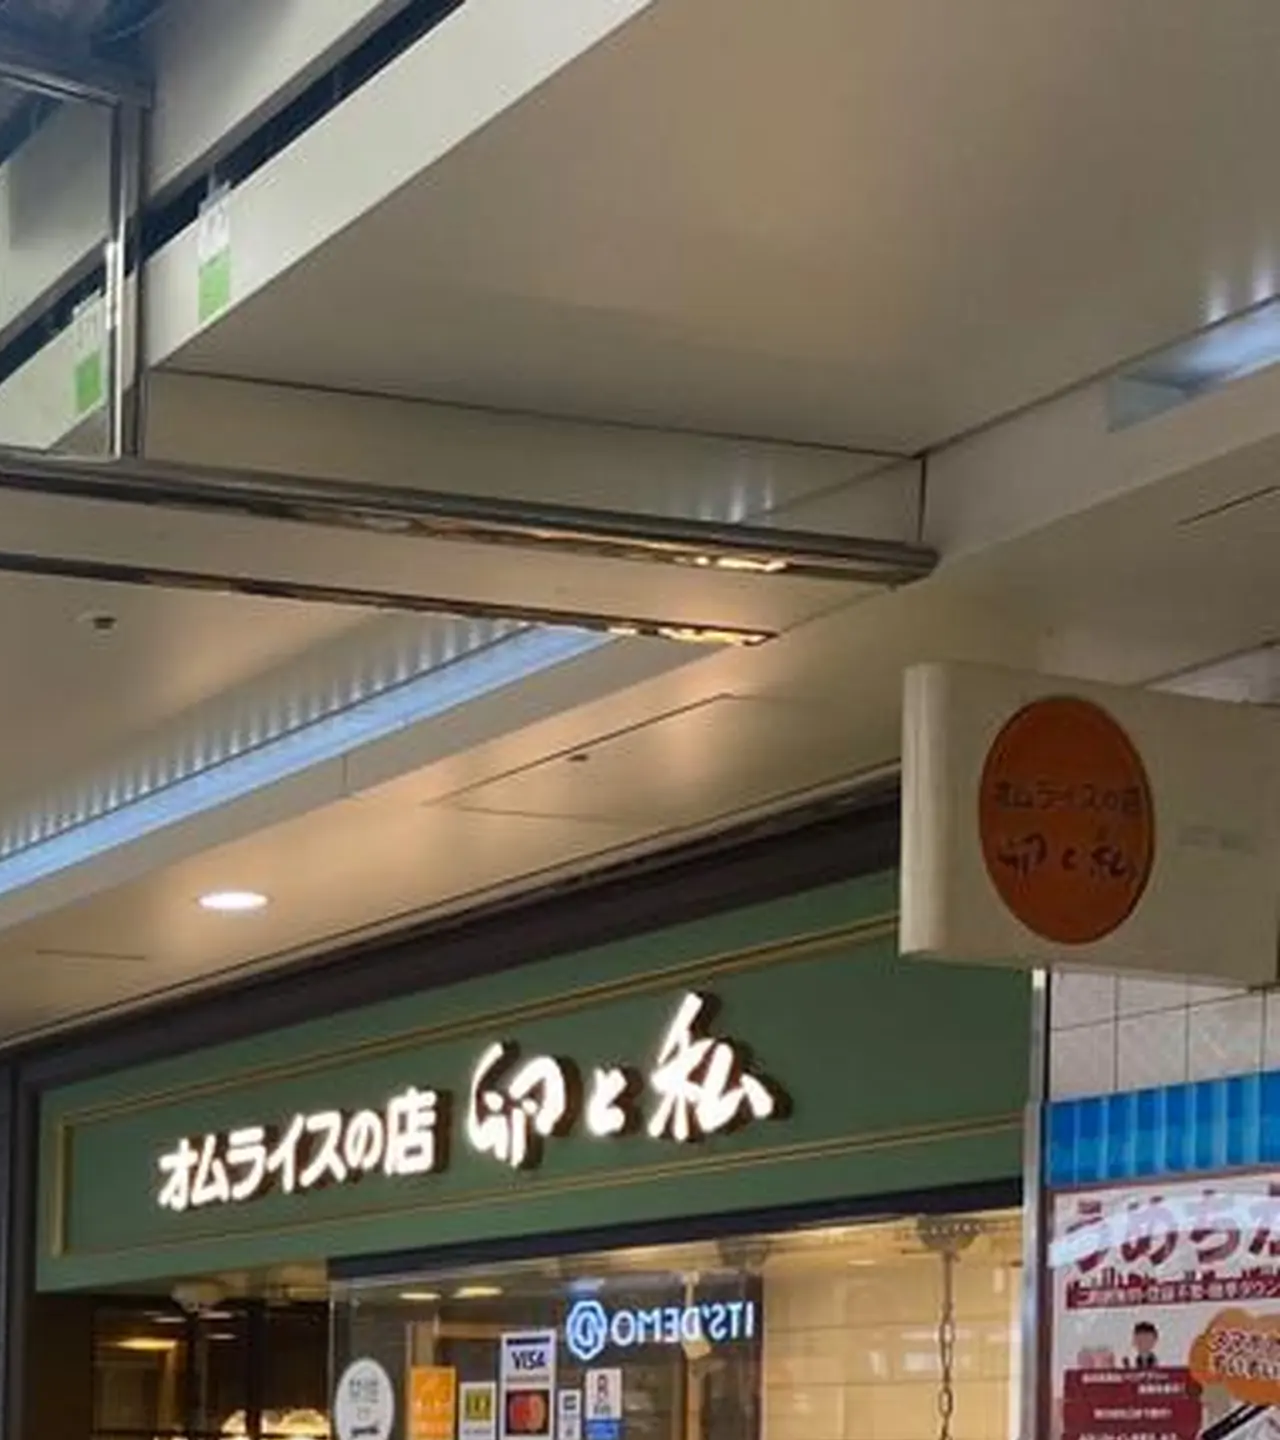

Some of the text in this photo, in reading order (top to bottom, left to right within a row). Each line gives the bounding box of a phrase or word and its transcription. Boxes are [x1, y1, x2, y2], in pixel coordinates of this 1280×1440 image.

[157, 992, 774, 1211] オムライスの店 卵と私
[511, 1350, 546, 1371] VISA
